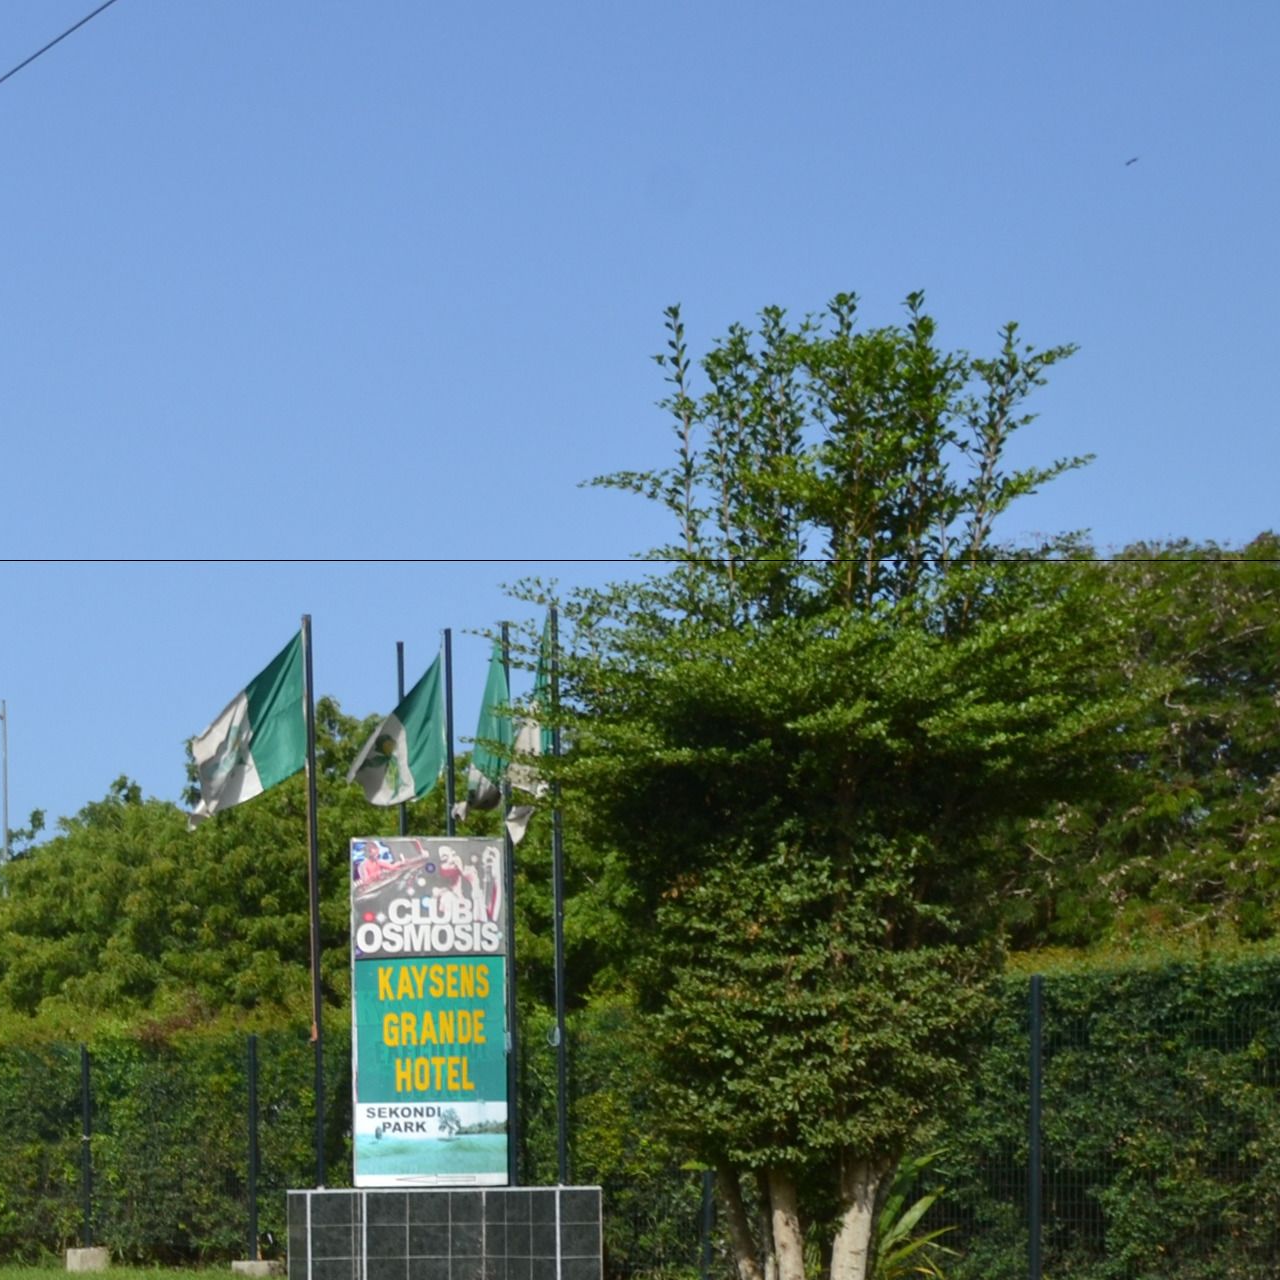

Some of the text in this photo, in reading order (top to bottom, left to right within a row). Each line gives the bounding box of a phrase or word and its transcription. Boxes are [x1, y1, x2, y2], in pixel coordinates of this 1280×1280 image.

[388, 898, 475, 923] CLUB
[356, 922, 499, 953] OSMOSIS
[378, 964, 490, 1000] KAYSENS
[383, 1011, 486, 1047] GRANDE
[395, 1056, 475, 1092] HOTEL
[366, 1106, 442, 1119] SEKONDI
[382, 1121, 428, 1133] PARK
